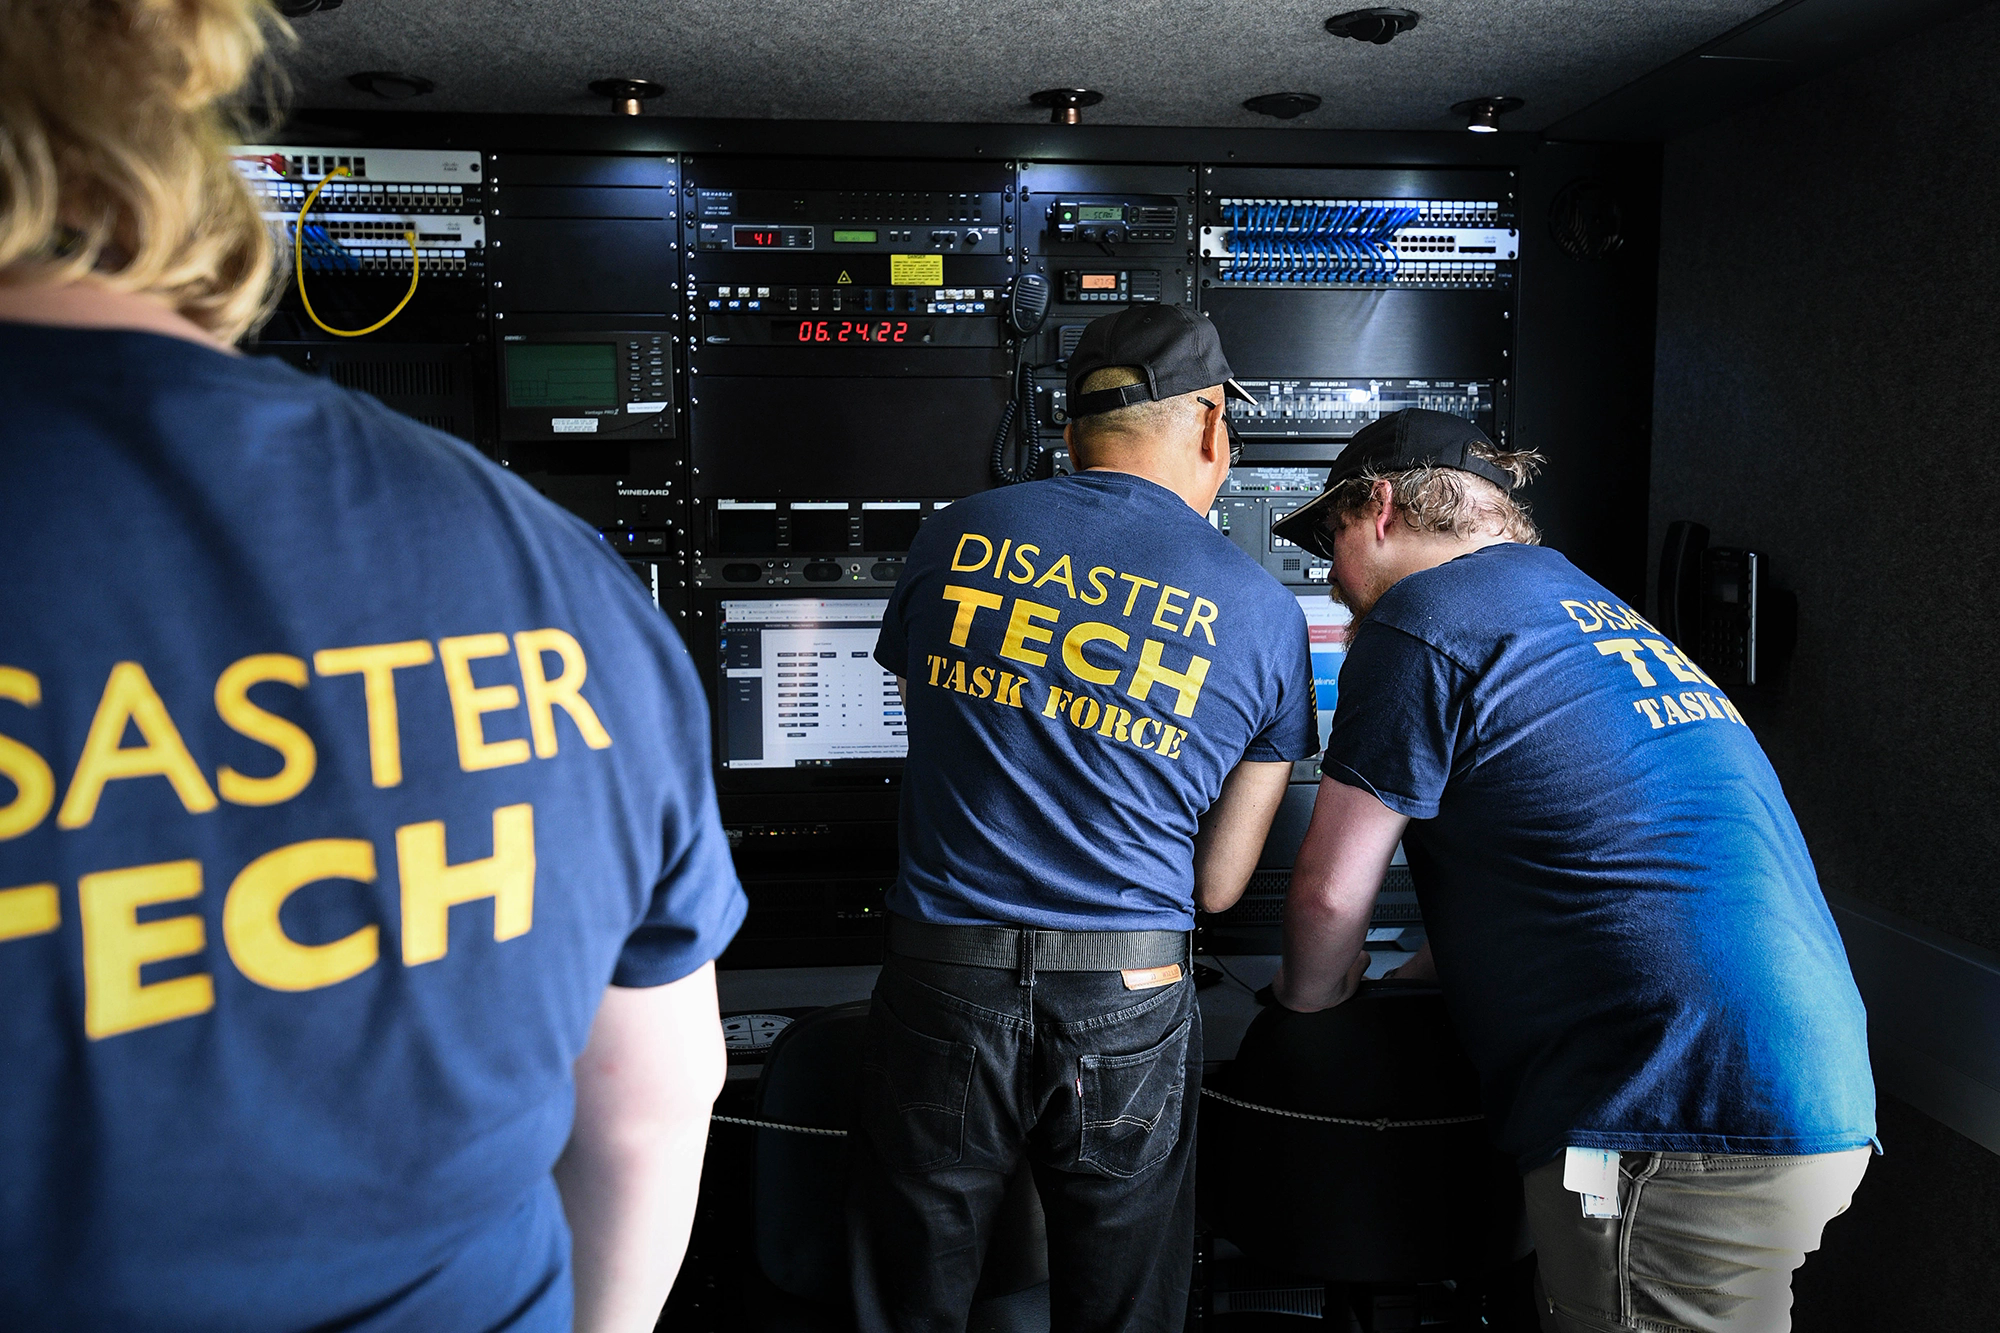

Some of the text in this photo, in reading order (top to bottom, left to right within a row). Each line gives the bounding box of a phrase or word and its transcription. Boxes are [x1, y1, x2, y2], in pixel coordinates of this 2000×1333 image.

[798, 321, 908, 342] 06.24.22
[950, 533, 1220, 647] DISASTER
[1559, 599, 1661, 636] DISA
[942, 585, 1212, 719] TECH
[926, 654, 1189, 760] TASK FORCE
[1633, 692, 1725, 729] TASK
